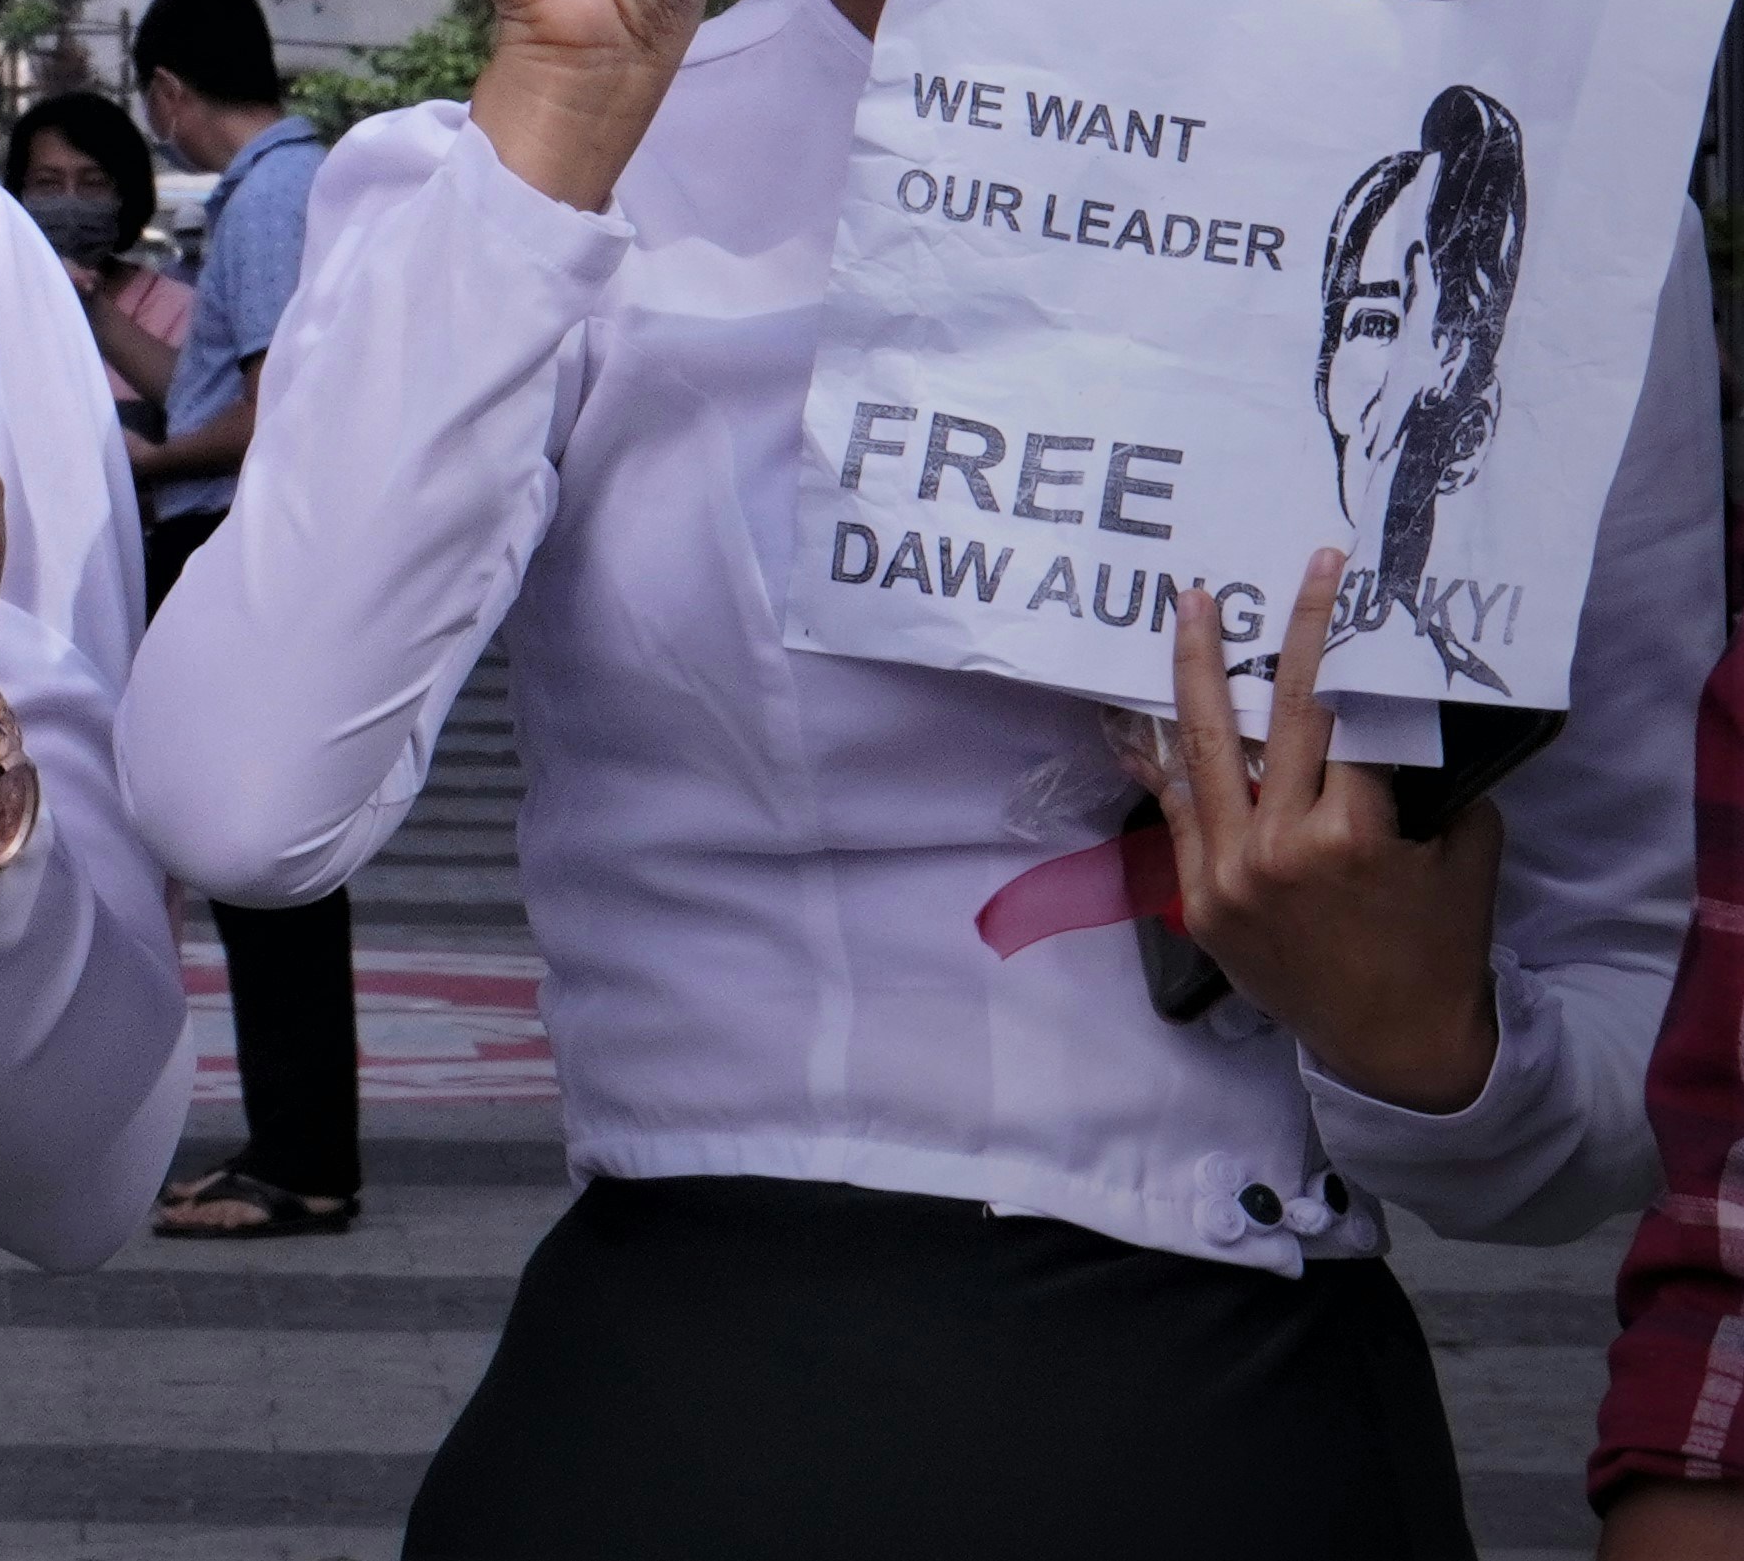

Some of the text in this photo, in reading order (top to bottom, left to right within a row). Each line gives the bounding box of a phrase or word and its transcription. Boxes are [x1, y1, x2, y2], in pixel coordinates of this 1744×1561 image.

[913, 73, 1206, 163] WE WANT
[896, 168, 1286, 272] OUR LEADER
[839, 400, 1184, 541] FREE
[830, 520, 1014, 604] DAW
[1027, 553, 1266, 643] AUNG
